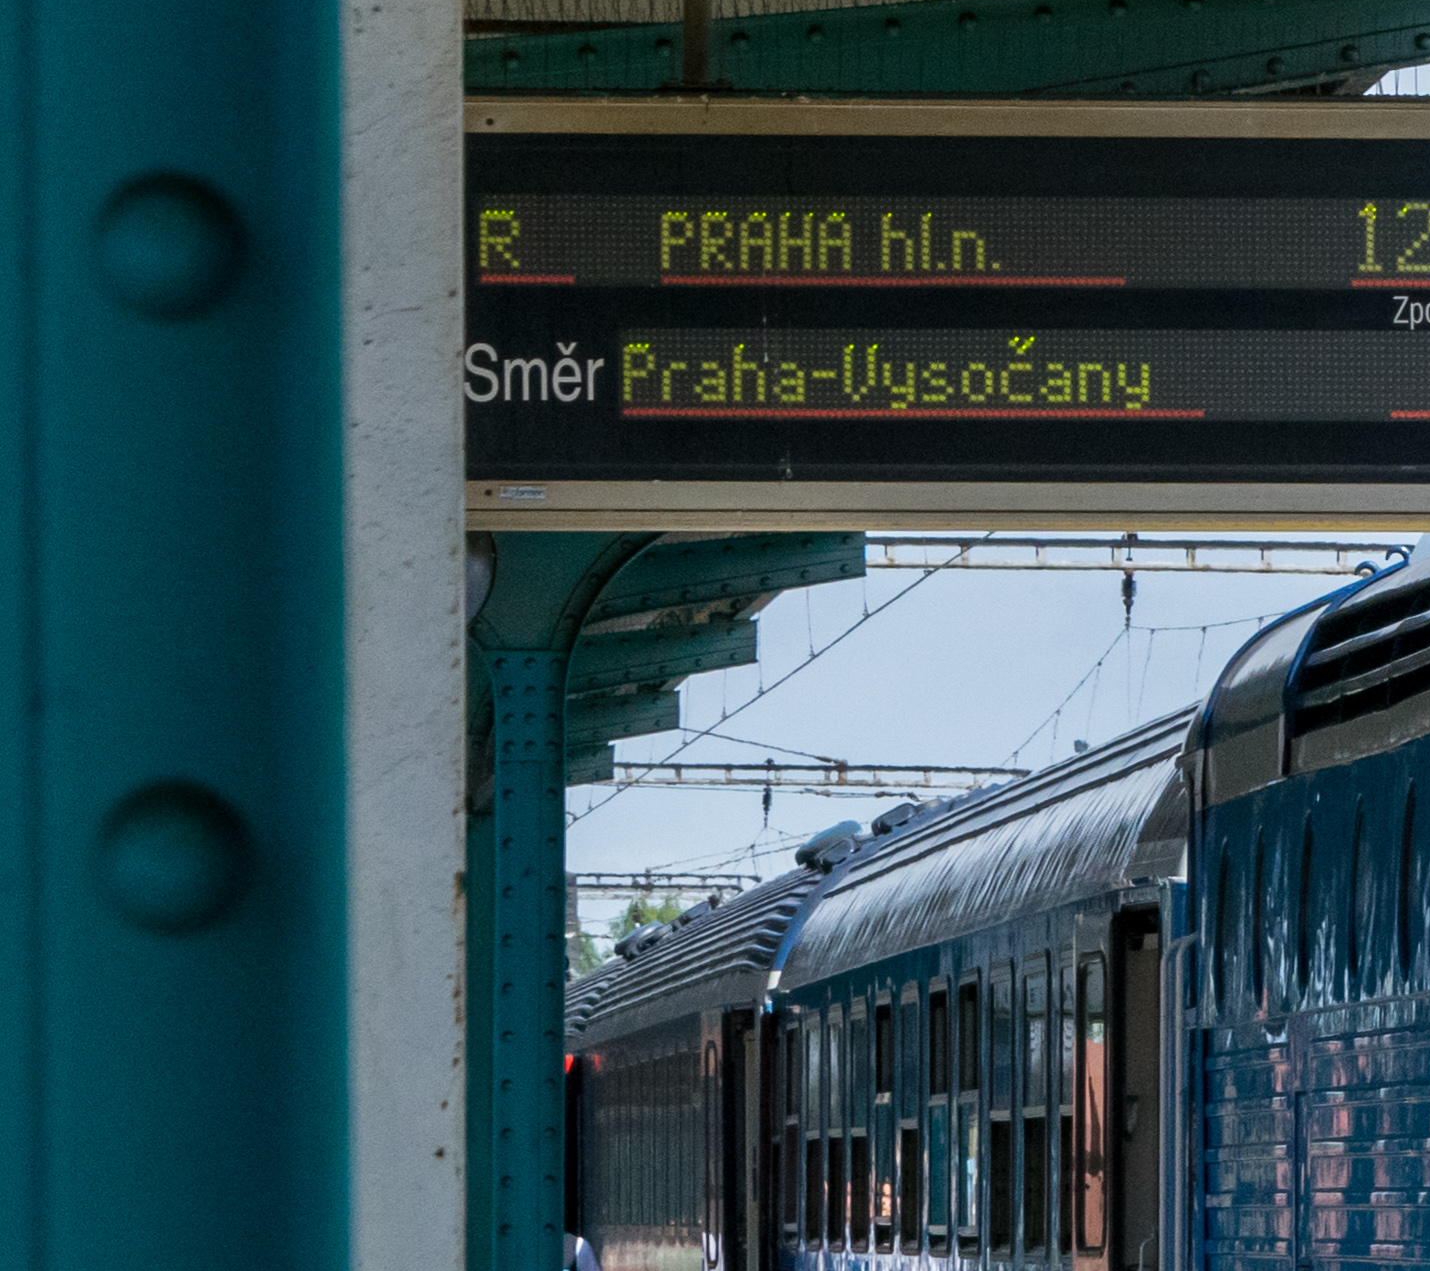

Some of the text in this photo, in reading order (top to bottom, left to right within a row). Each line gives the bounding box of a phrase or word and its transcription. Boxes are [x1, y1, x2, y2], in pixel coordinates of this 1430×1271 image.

[480, 210, 519, 269] R
[661, 211, 851, 271] PRAHA
[882, 212, 1000, 271] hl.n.
[464, 341, 604, 402] Směr
[623, 336, 1150, 409] Praha-Vysočany
